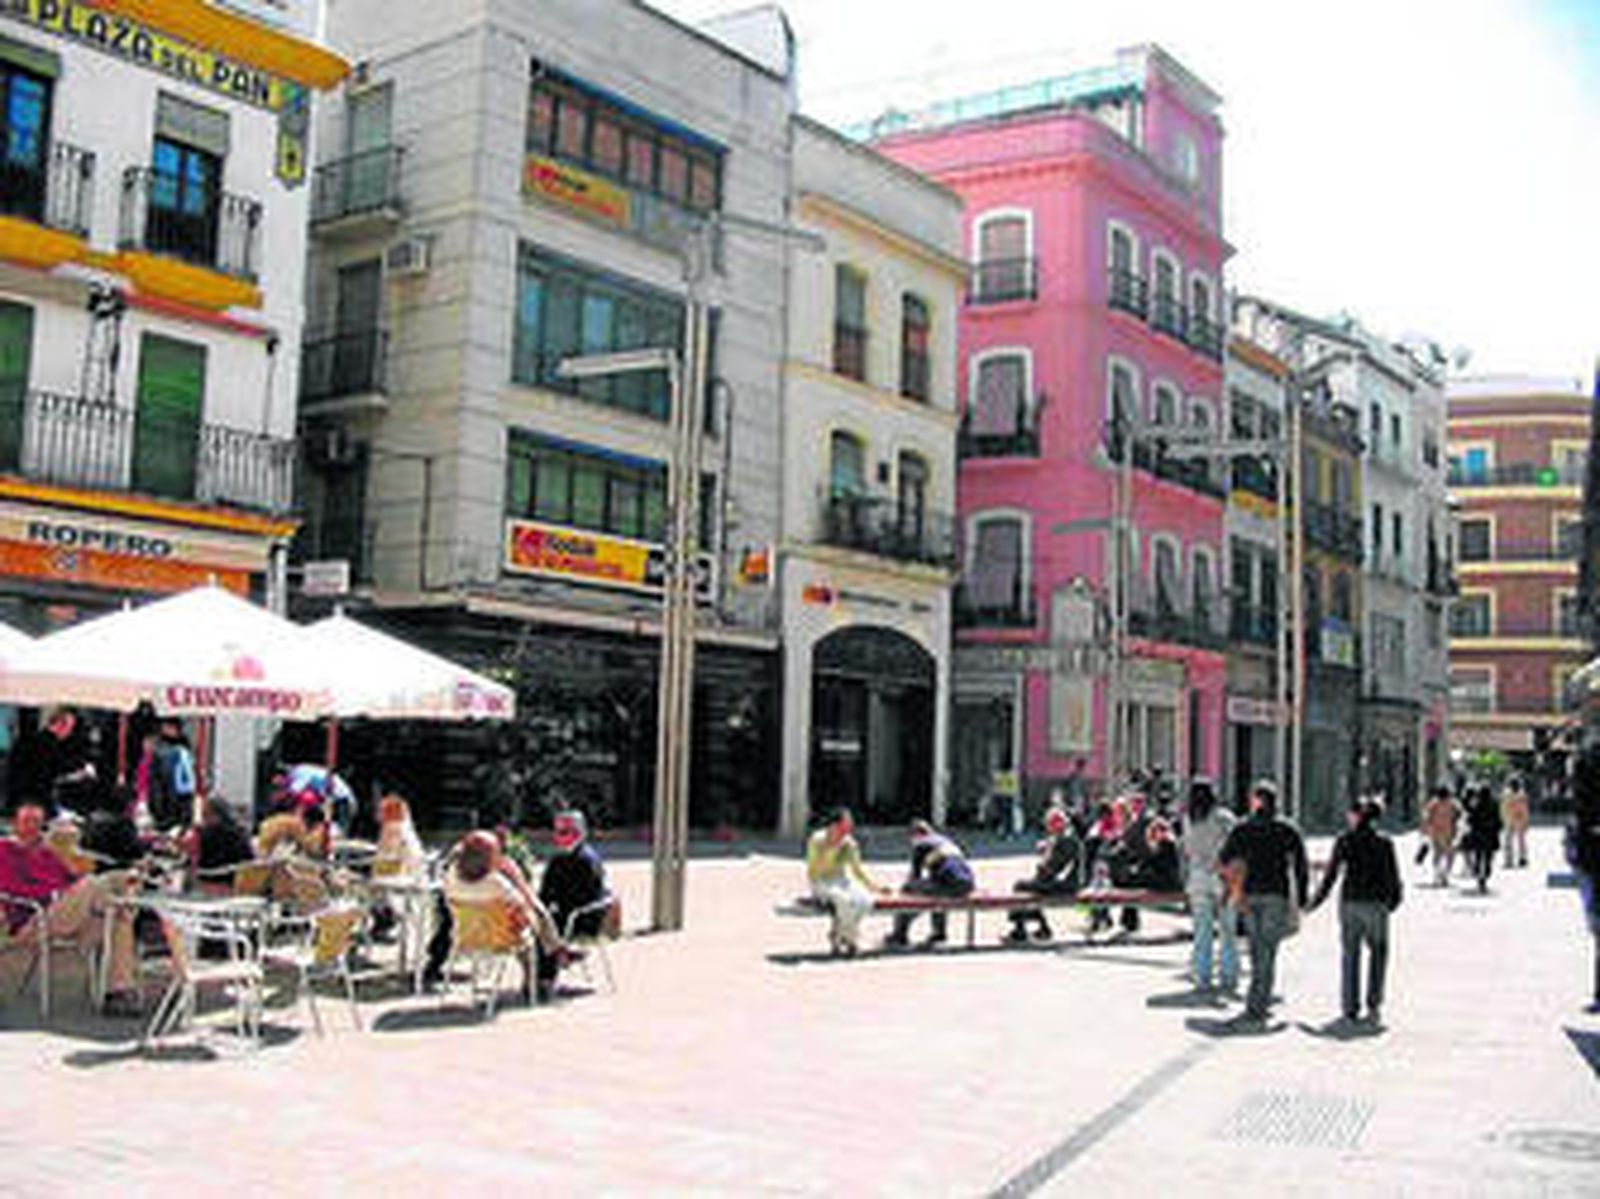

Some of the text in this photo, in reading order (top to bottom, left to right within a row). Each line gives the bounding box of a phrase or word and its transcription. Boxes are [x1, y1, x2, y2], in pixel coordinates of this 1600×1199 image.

[38, 0, 154, 62] PLAZA
[213, 59, 268, 101] PAN
[28, 521, 172, 556] ROPERO
